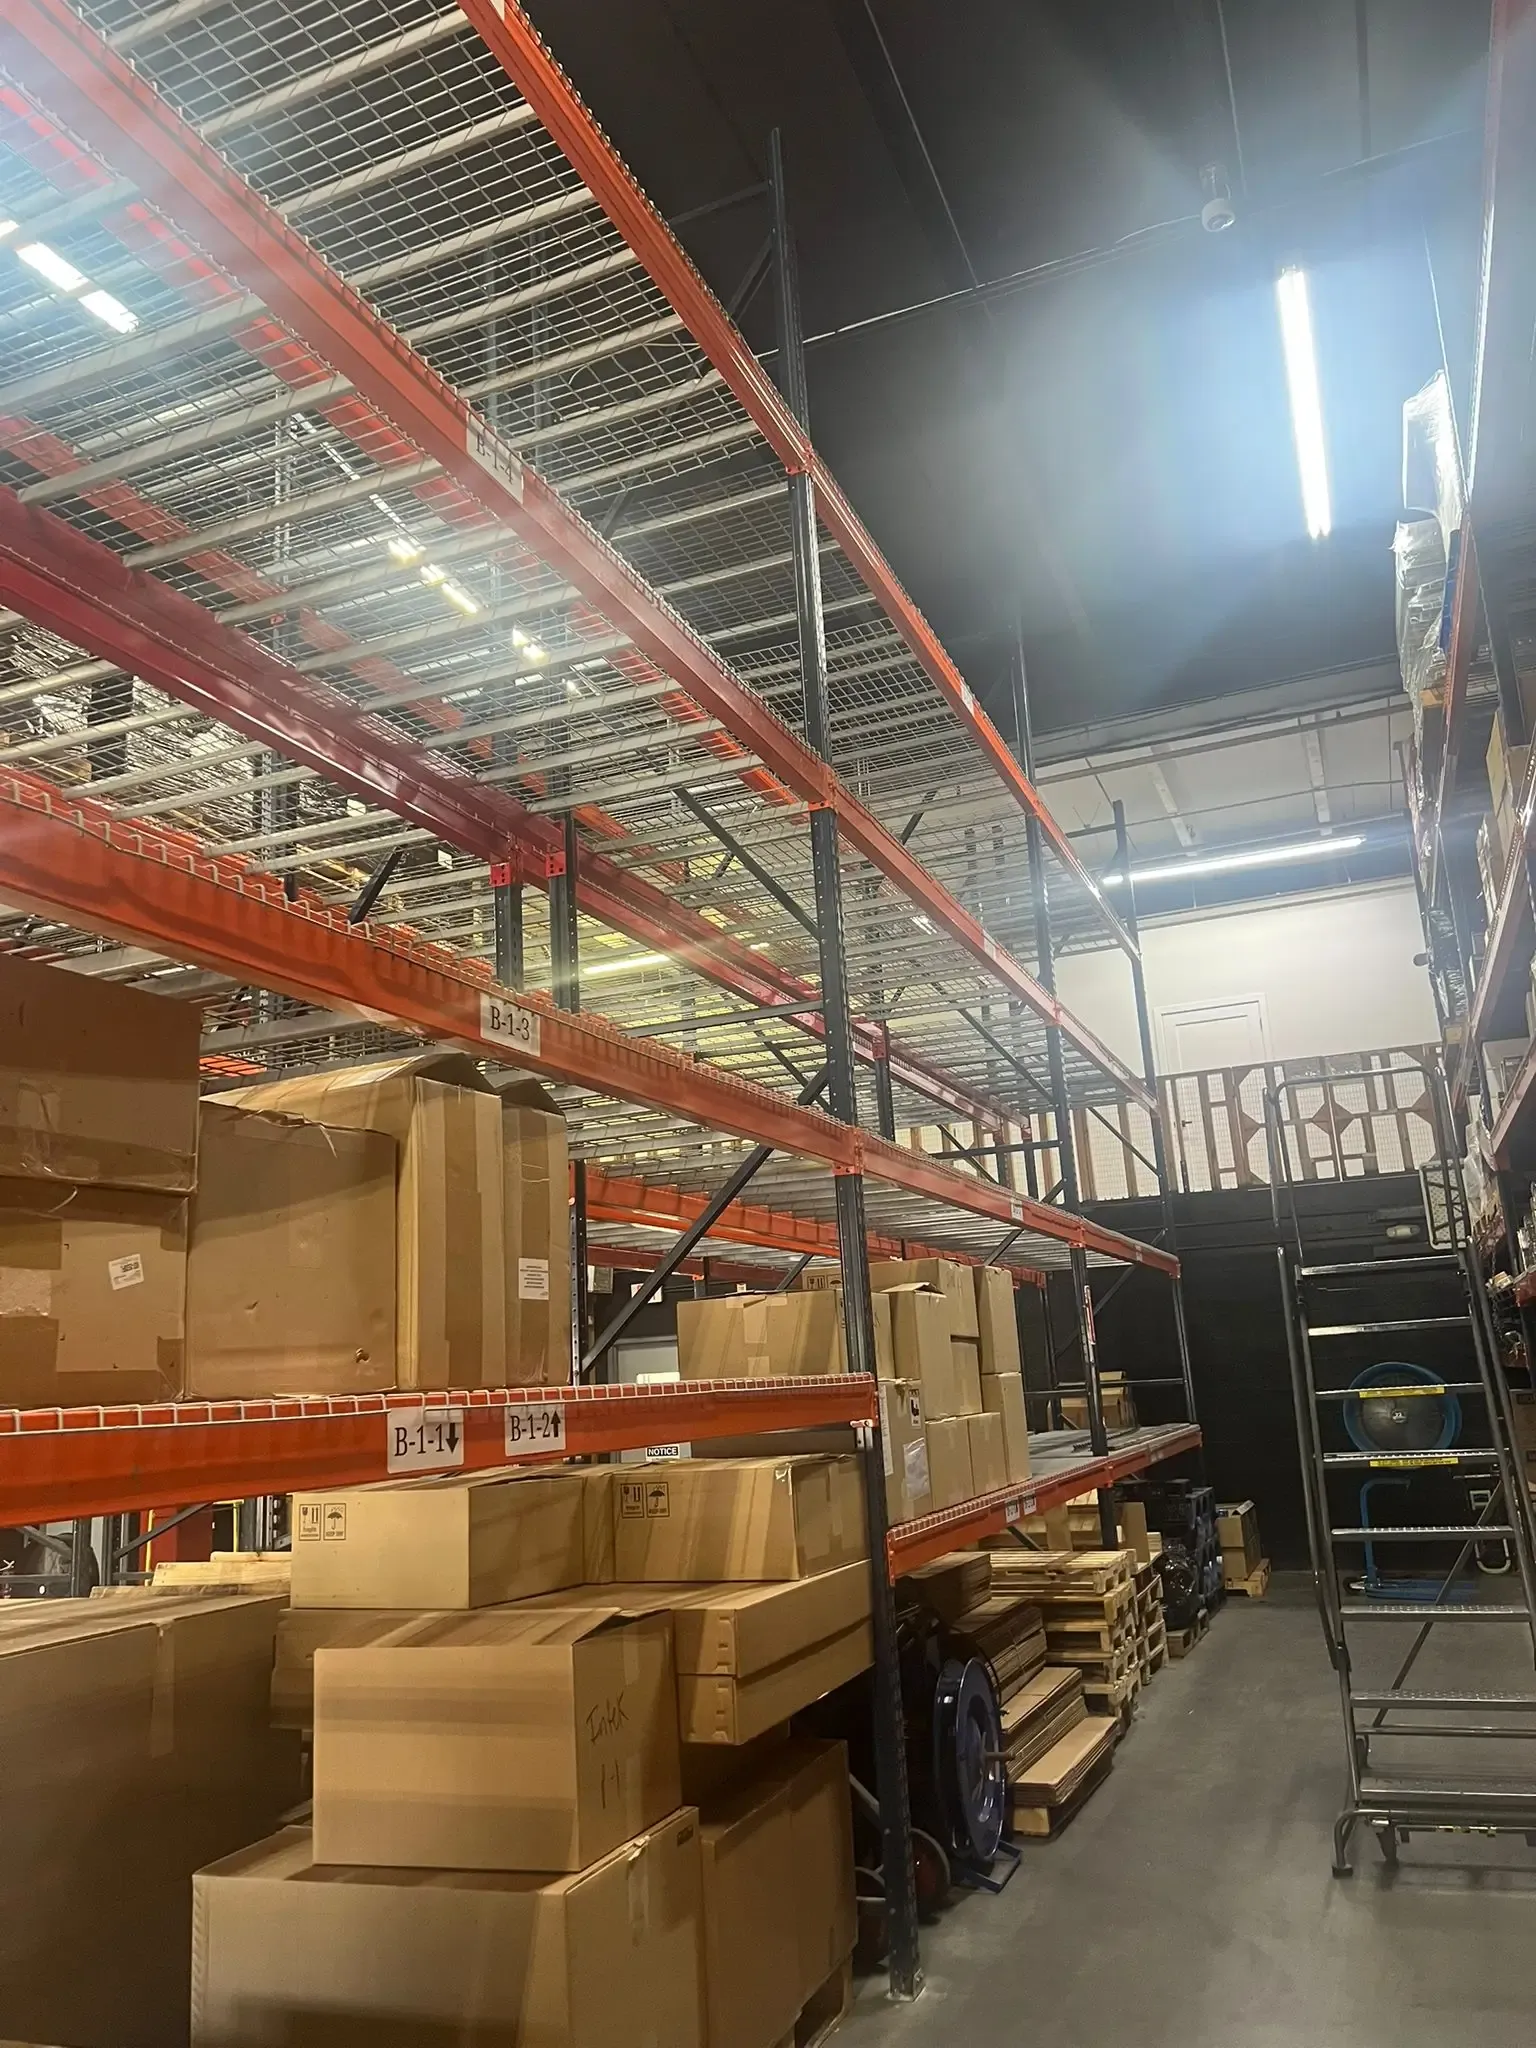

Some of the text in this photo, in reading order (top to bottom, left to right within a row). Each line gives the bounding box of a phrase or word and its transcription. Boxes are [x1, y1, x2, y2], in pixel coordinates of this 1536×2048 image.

[476, 433, 514, 486] B-1-4
[490, 1005, 530, 1040] B-1-3
[394, 1423, 444, 1457] B-1-1
[510, 1412, 550, 1442] B-1-2
[648, 1446, 677, 1457] NOTICE
